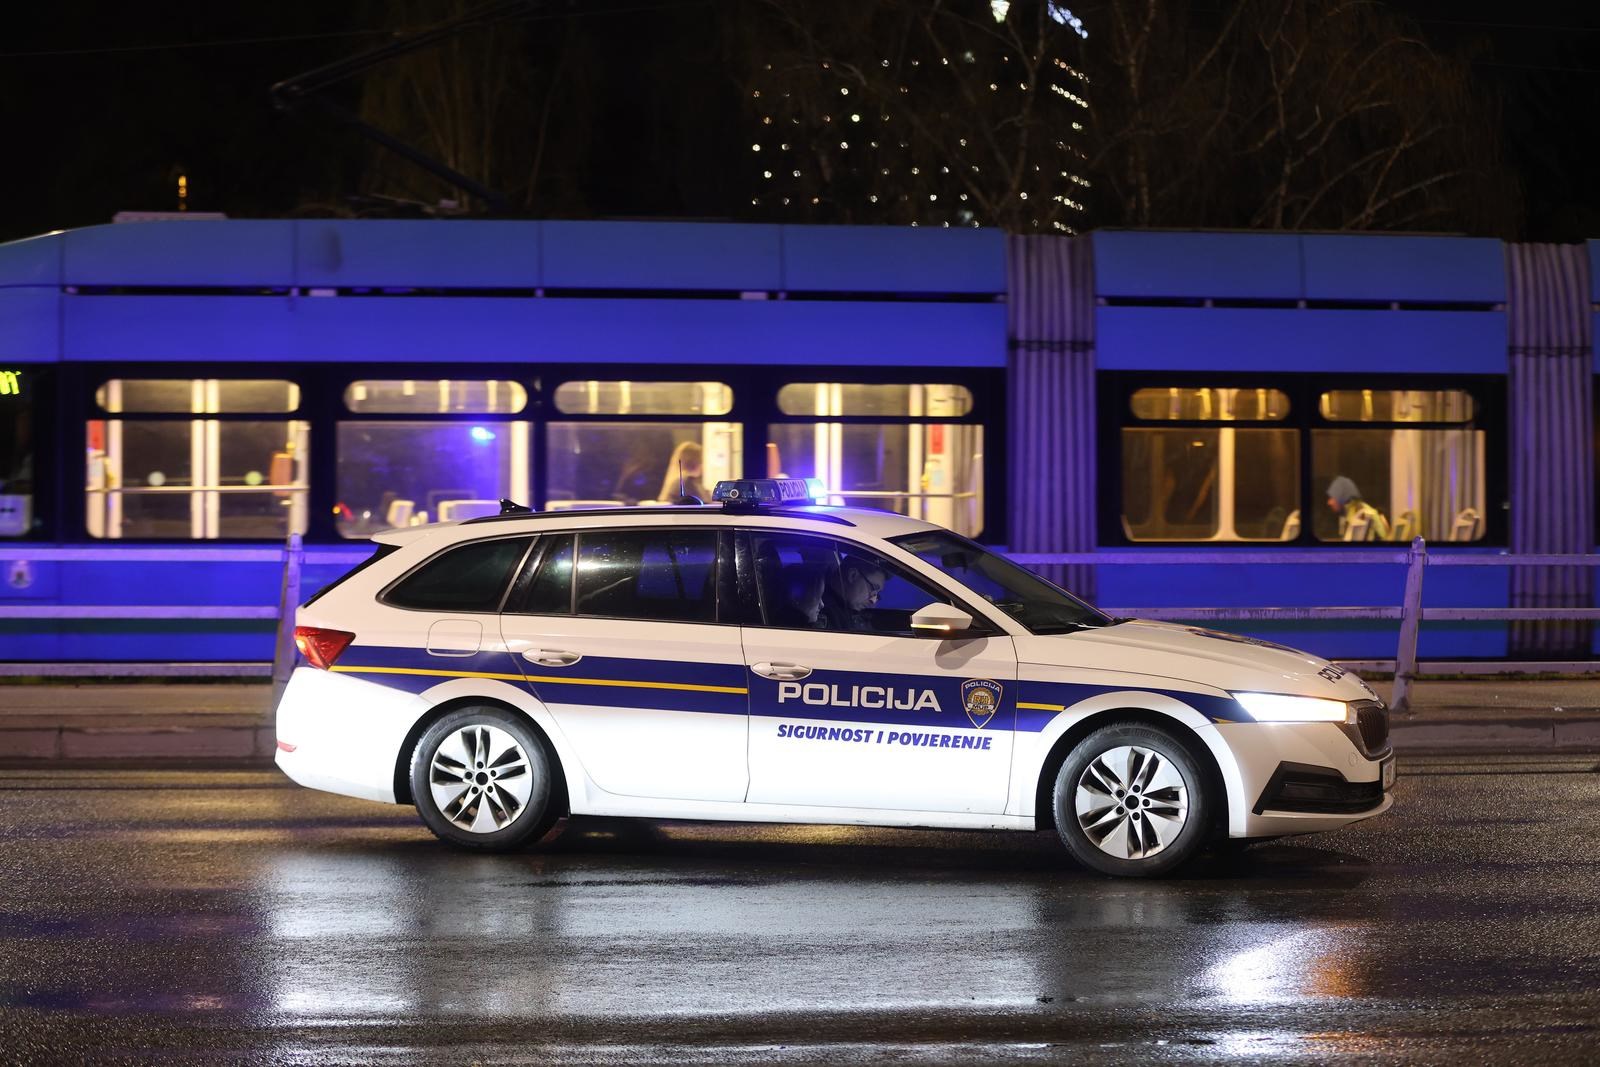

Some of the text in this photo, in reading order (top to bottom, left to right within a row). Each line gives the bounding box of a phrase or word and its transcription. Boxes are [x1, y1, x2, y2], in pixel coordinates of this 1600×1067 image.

[778, 682, 942, 712] POLICIJA
[964, 681, 1000, 693] POLICIJA
[777, 724, 993, 751] SIGURNOST I POVJERENJE
